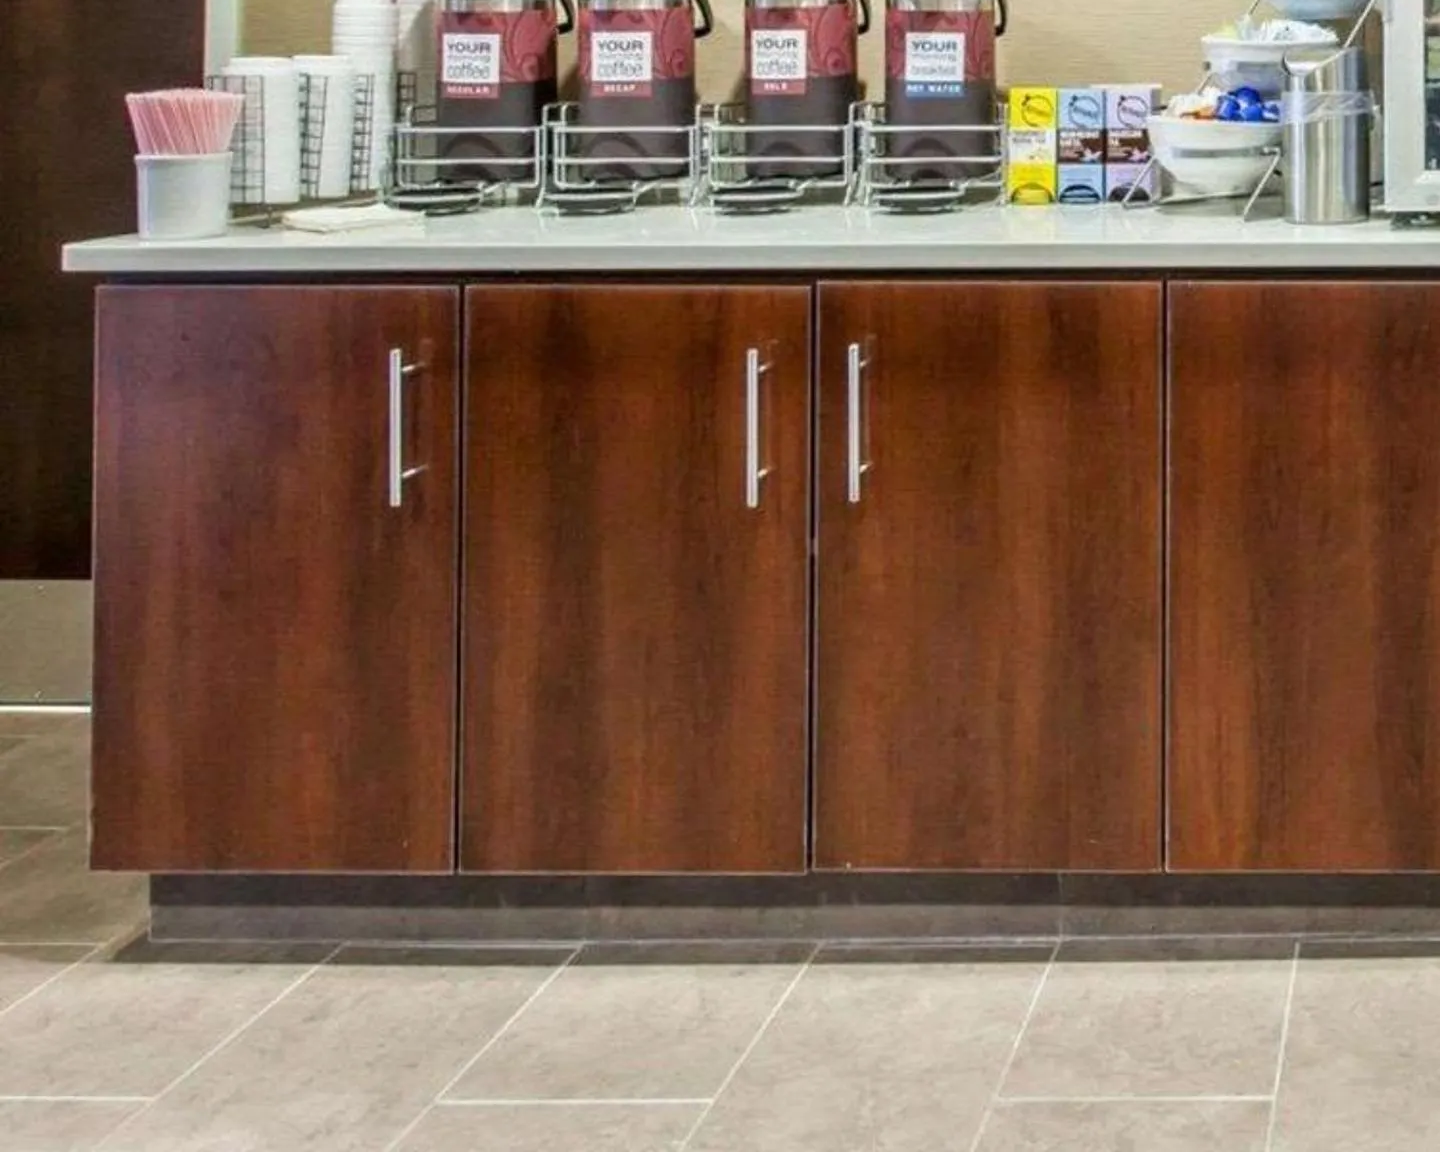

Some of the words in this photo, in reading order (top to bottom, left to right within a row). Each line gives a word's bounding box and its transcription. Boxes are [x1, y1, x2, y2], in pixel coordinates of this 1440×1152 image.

[447, 41, 492, 54] YOUR
[597, 39, 644, 52] YOUR
[756, 37, 799, 49] YOUR
[911, 39, 958, 52] YOUR
